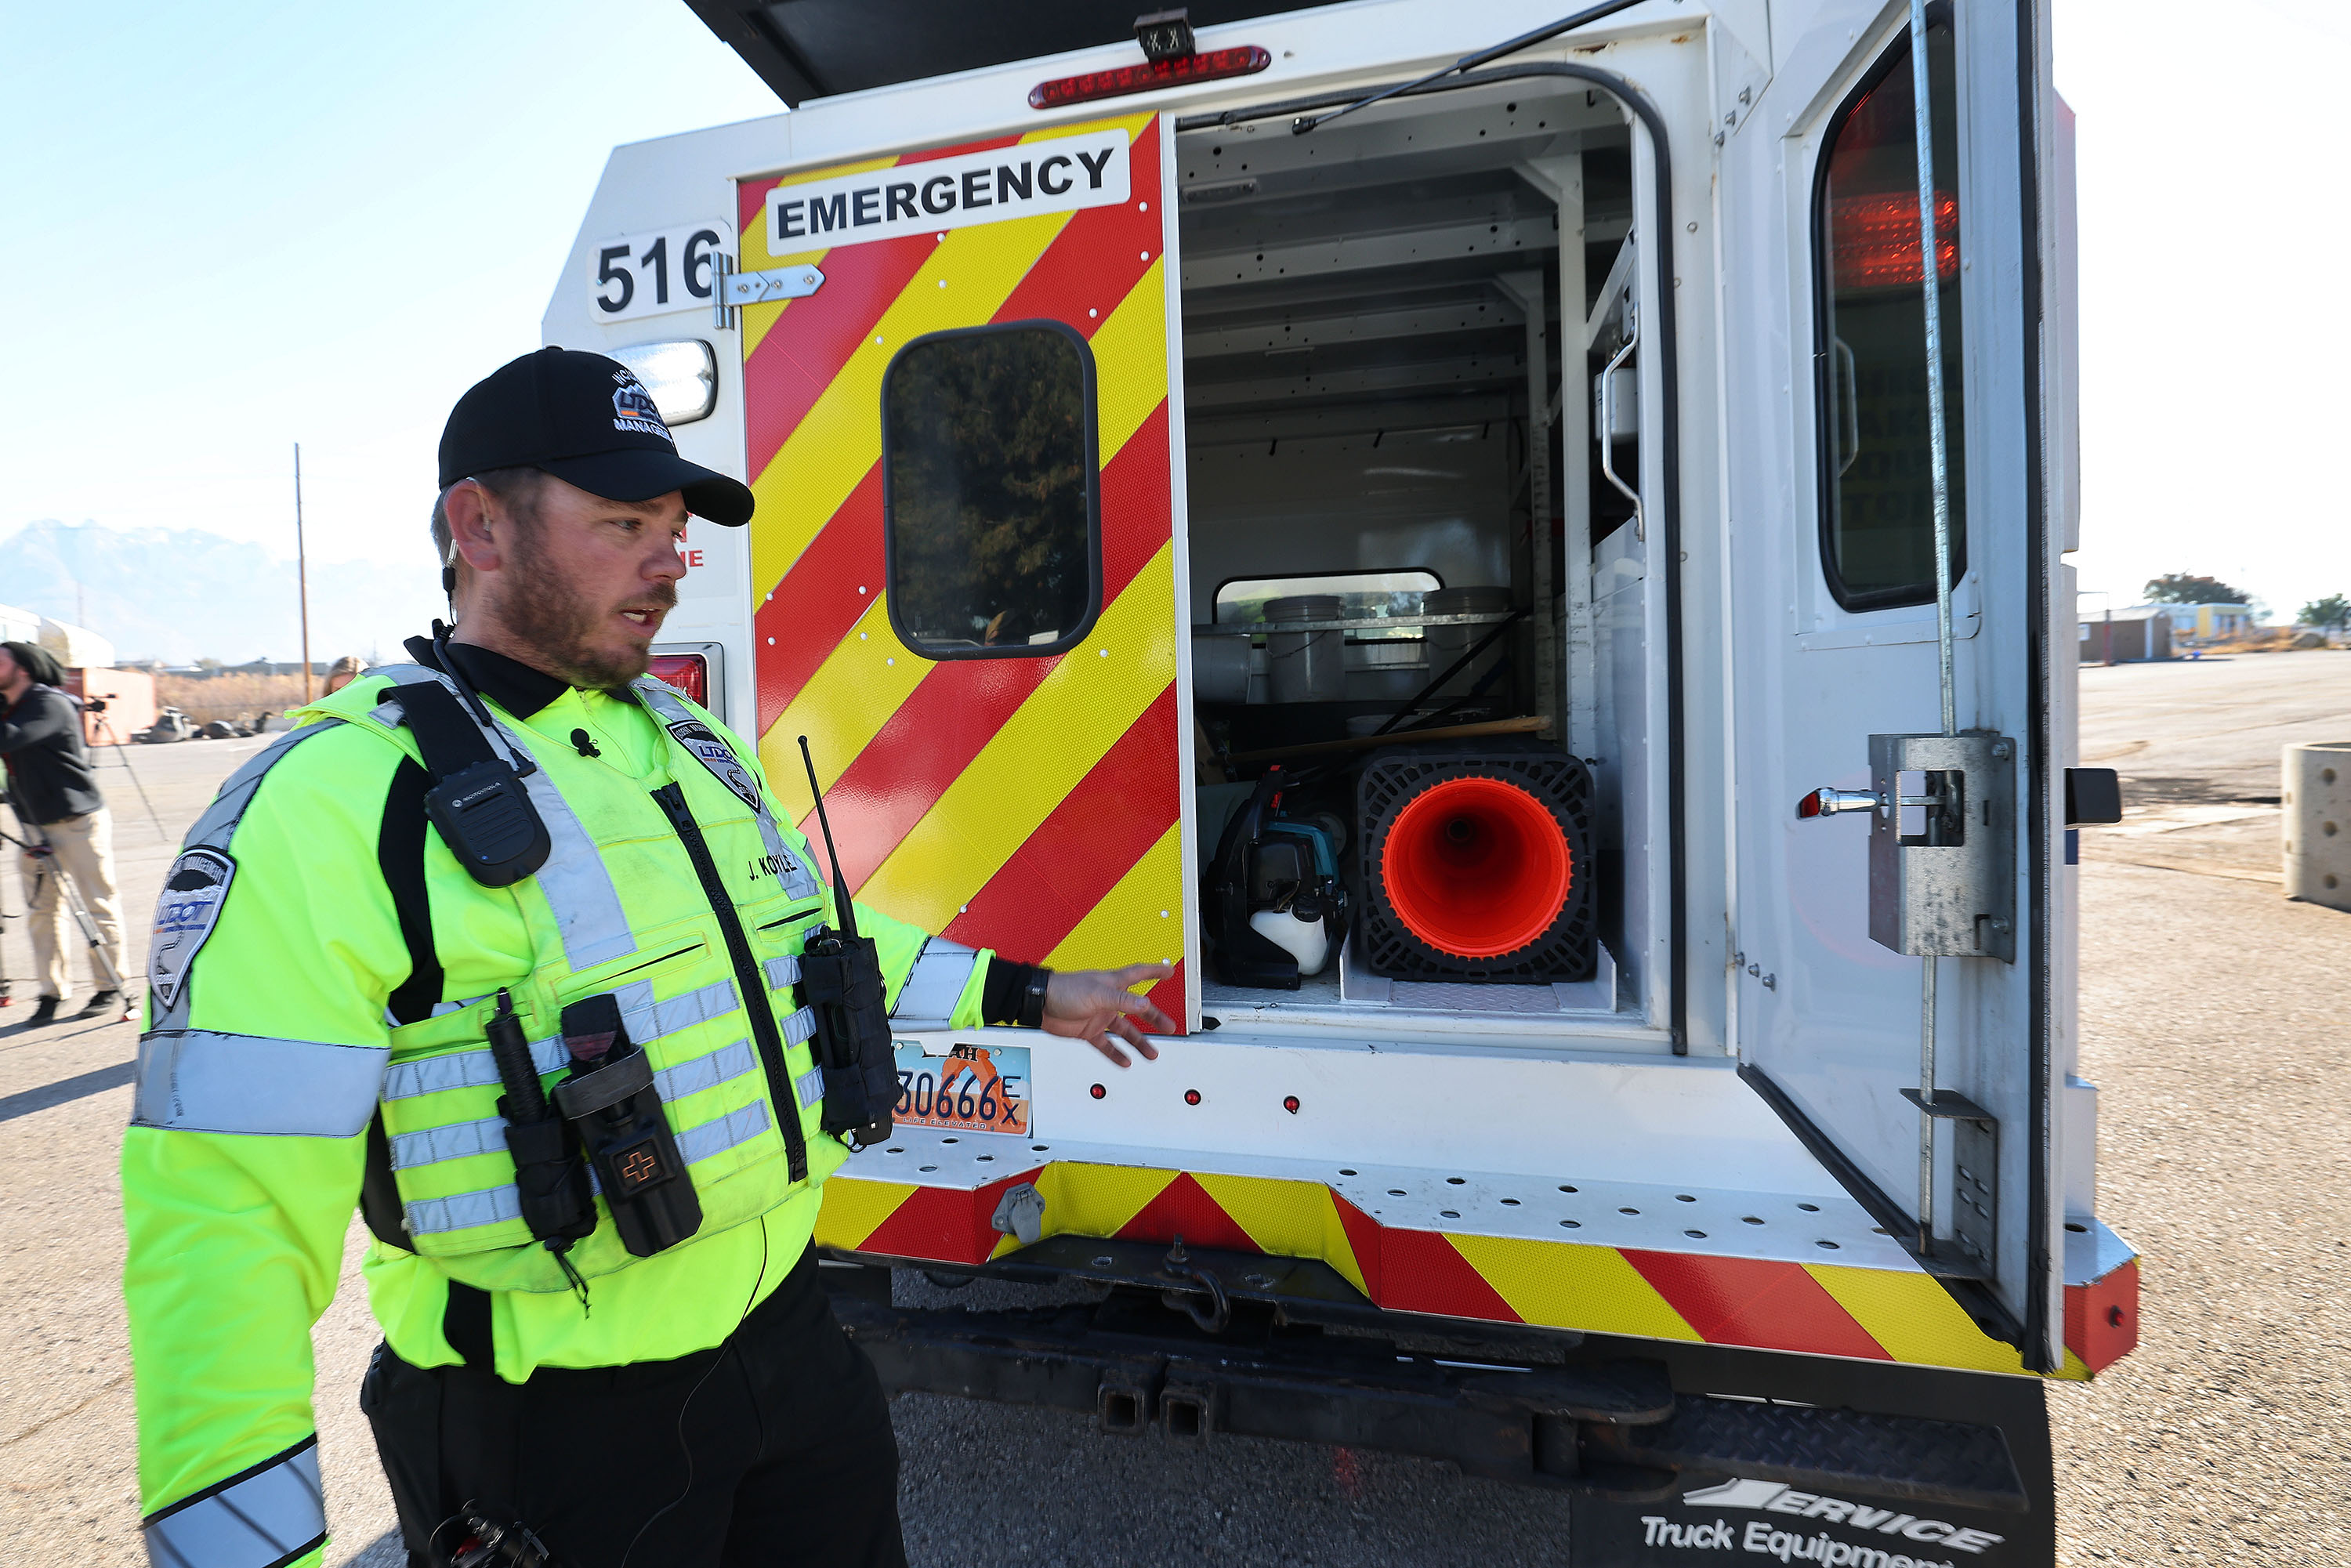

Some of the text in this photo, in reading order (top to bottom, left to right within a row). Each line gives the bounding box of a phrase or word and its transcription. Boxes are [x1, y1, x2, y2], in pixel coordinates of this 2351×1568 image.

[777, 147, 1115, 240] EMERGENCY
[596, 230, 720, 312] 516
[748, 853, 798, 881] J. KOYLE
[930, 1118, 987, 1129] ELEVATED
[1641, 1515, 1736, 1551] Truck
